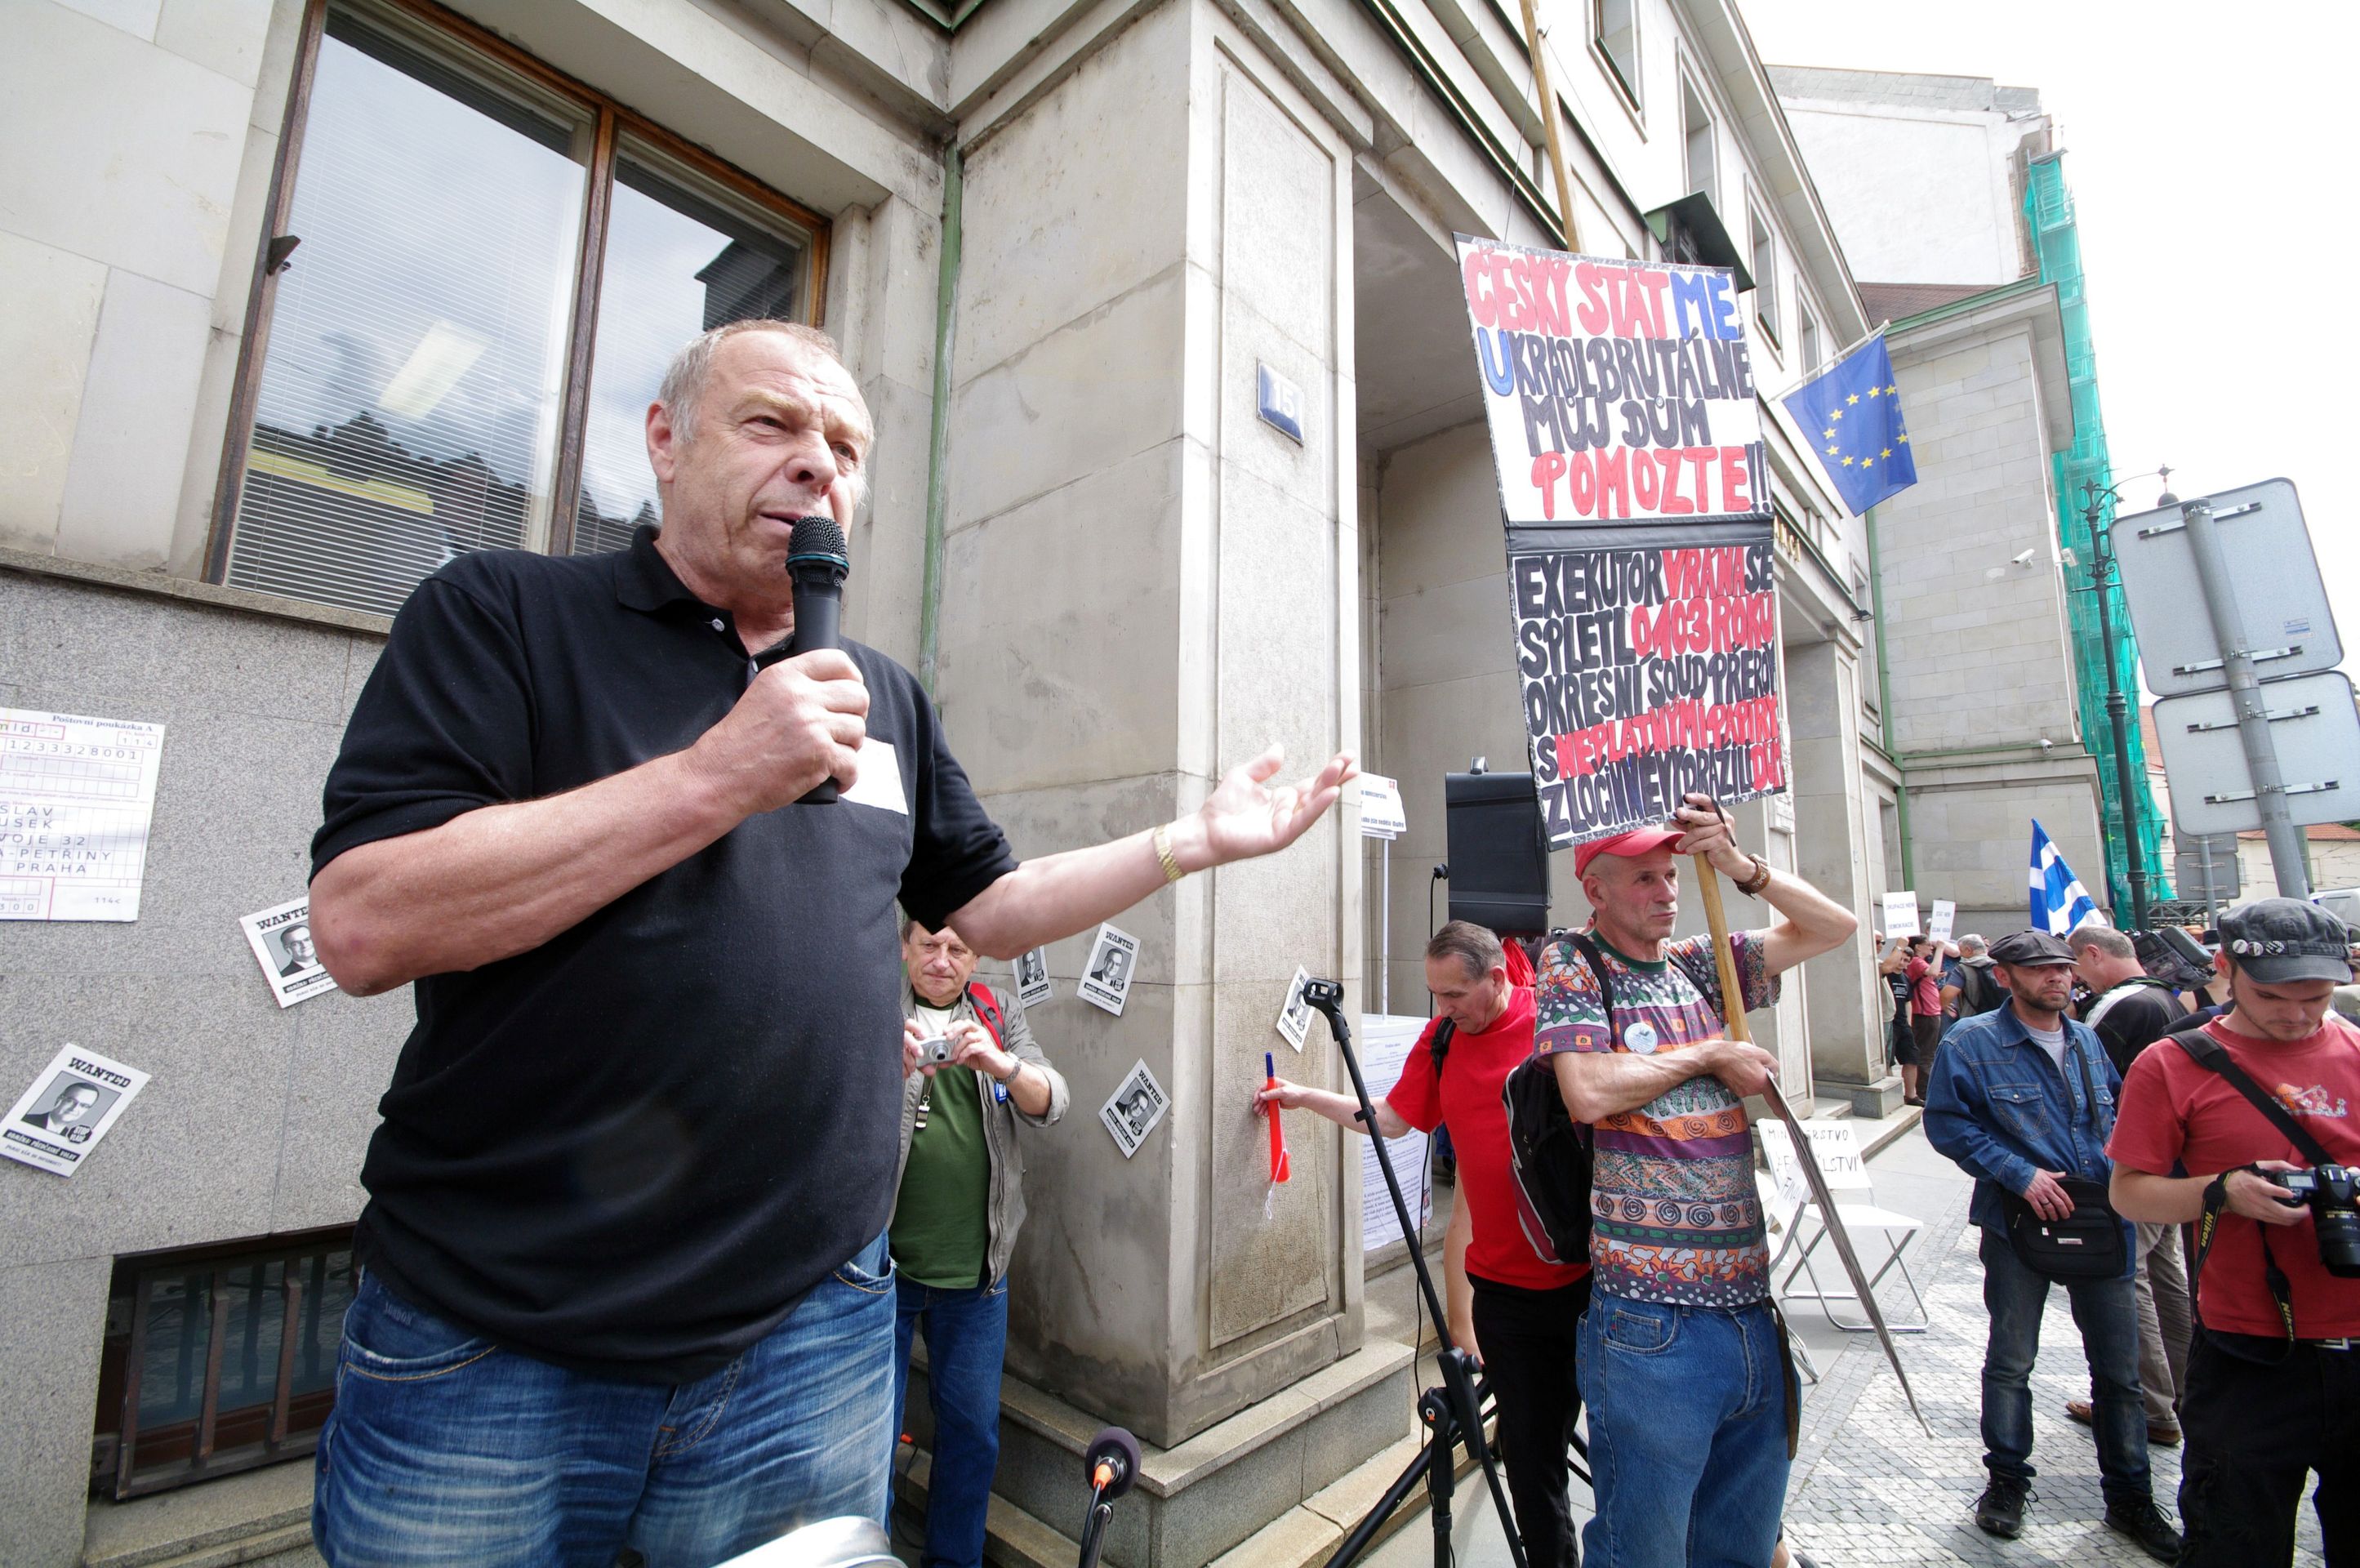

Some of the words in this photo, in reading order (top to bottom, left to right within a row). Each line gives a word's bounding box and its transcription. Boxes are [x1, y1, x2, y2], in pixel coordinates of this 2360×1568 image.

[1464, 247, 1573, 337] ČESKÝ
[1575, 262, 1669, 340] STÁT
[1477, 327, 1597, 397] UKRADL
[1521, 394, 1610, 457] MŮJ
[1622, 395, 1712, 449] DŮM
[1515, 550, 1665, 620] EXEKUTOR
[1663, 546, 1745, 600] VRÁNA
[1745, 546, 1774, 593] SE
[1520, 607, 1636, 679] SPLETL
[1526, 652, 1656, 737] OKRESNÍ
[1647, 654, 1708, 708] SOUD
[52, 714, 94, 728] Poštovní
[96, 719, 143, 733] poukázka
[145, 724, 153, 733] A
[1555, 694, 1710, 780] NEPLATNÝMI
[1706, 693, 1779, 751] PAPÍRY
[62, 835, 86, 846] 32
[16, 862, 86, 873] PRAHA
[256, 905, 309, 930] WANTE
[1106, 930, 1134, 951] WANTED
[69, 1057, 131, 1089] WANTED
[1138, 1068, 1163, 1106] WANTED
[2201, 1211, 2214, 1248] Nikon
